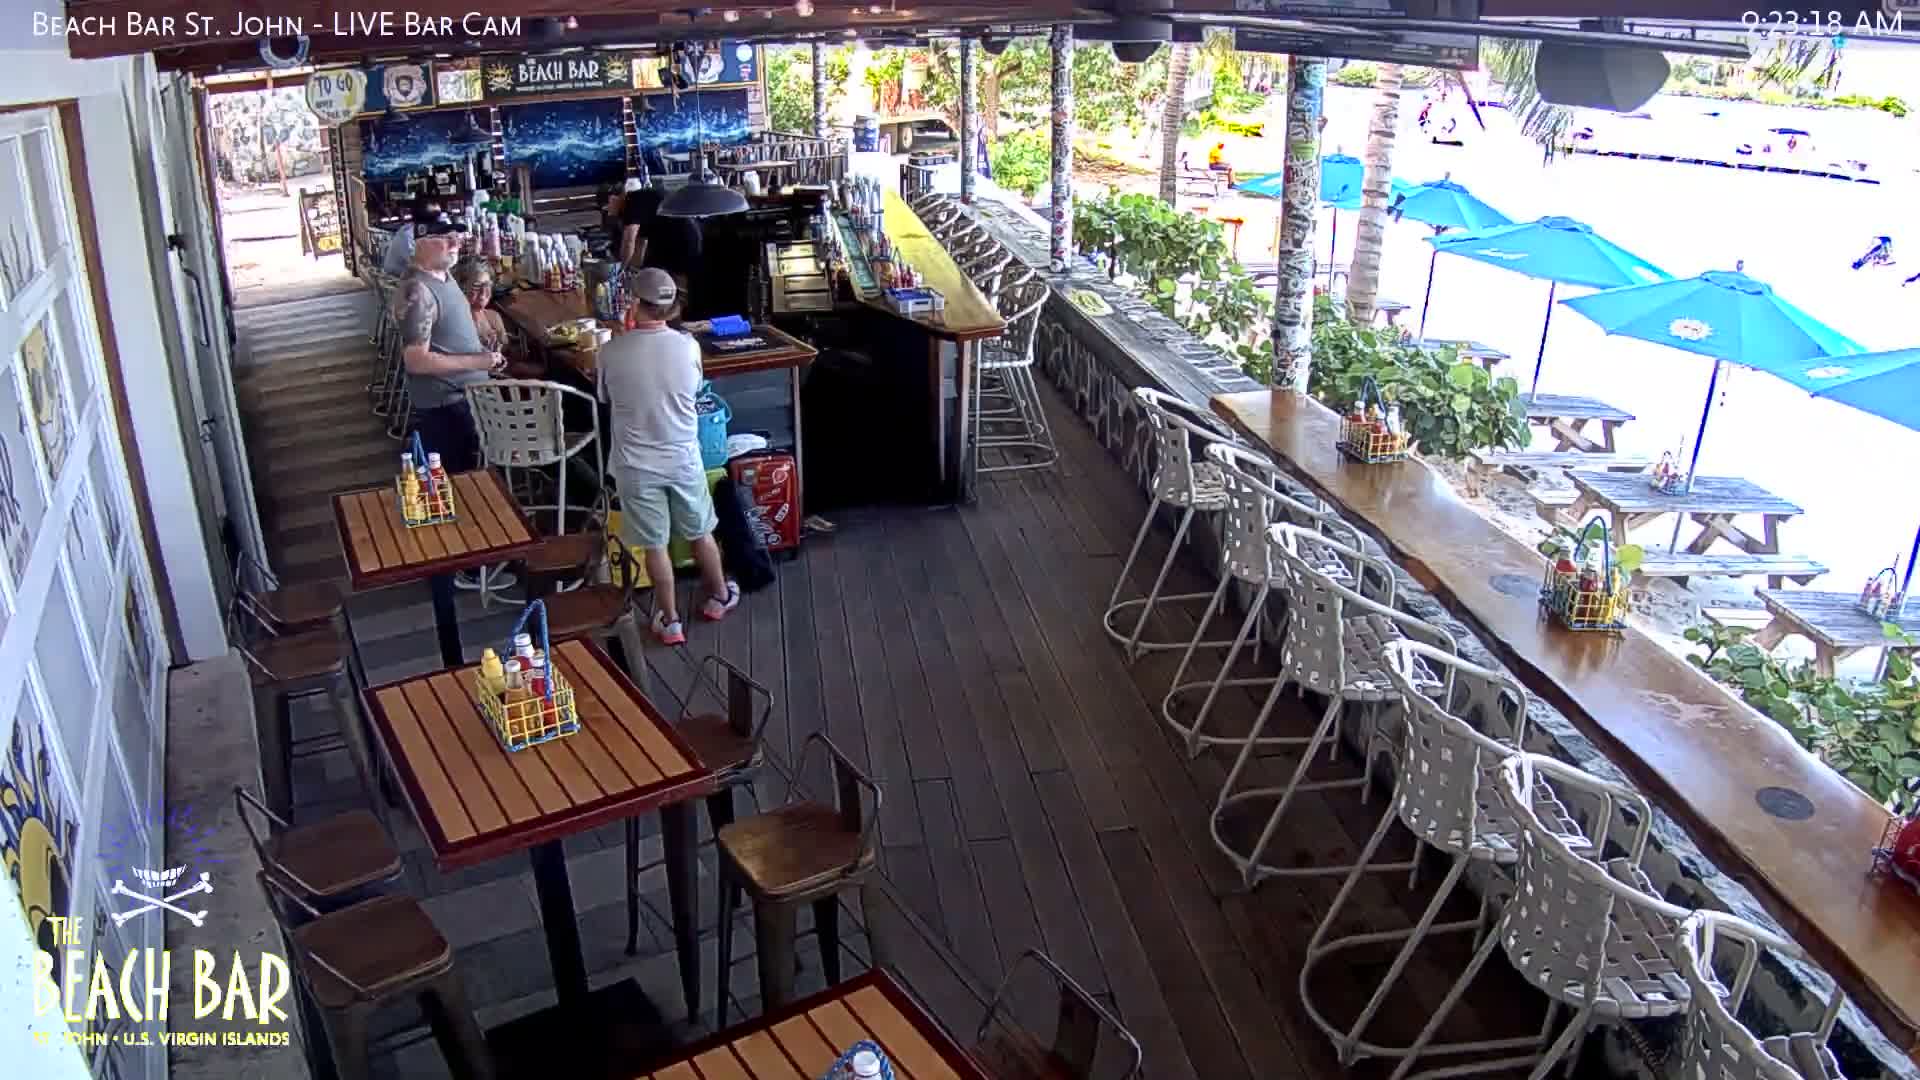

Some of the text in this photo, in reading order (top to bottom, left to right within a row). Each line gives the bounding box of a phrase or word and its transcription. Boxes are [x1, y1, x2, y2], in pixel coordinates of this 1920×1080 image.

[518, 61, 563, 83] BEACH
[568, 59, 600, 80] BAR
[314, 76, 332, 96] TO
